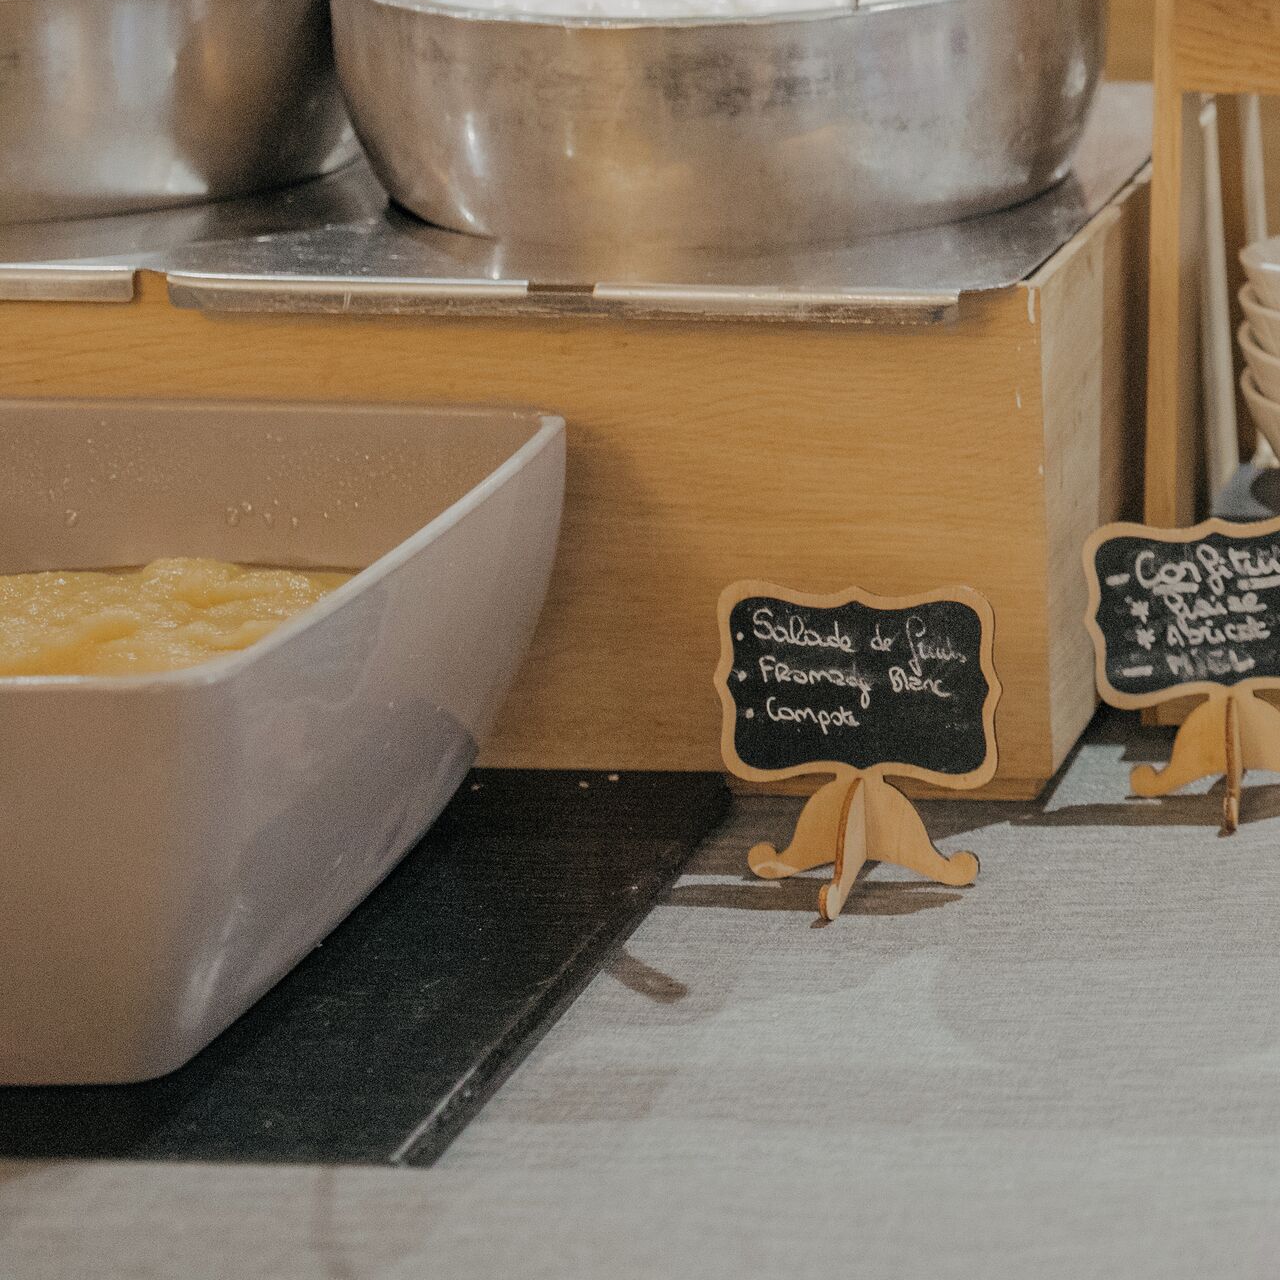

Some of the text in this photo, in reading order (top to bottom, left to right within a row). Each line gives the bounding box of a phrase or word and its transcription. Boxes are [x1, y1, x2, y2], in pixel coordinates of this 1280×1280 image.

[753, 607, 855, 653] Salade
[870, 623, 892, 651] de
[888, 666, 950, 698] Blanc
[766, 696, 860, 735] Compote
